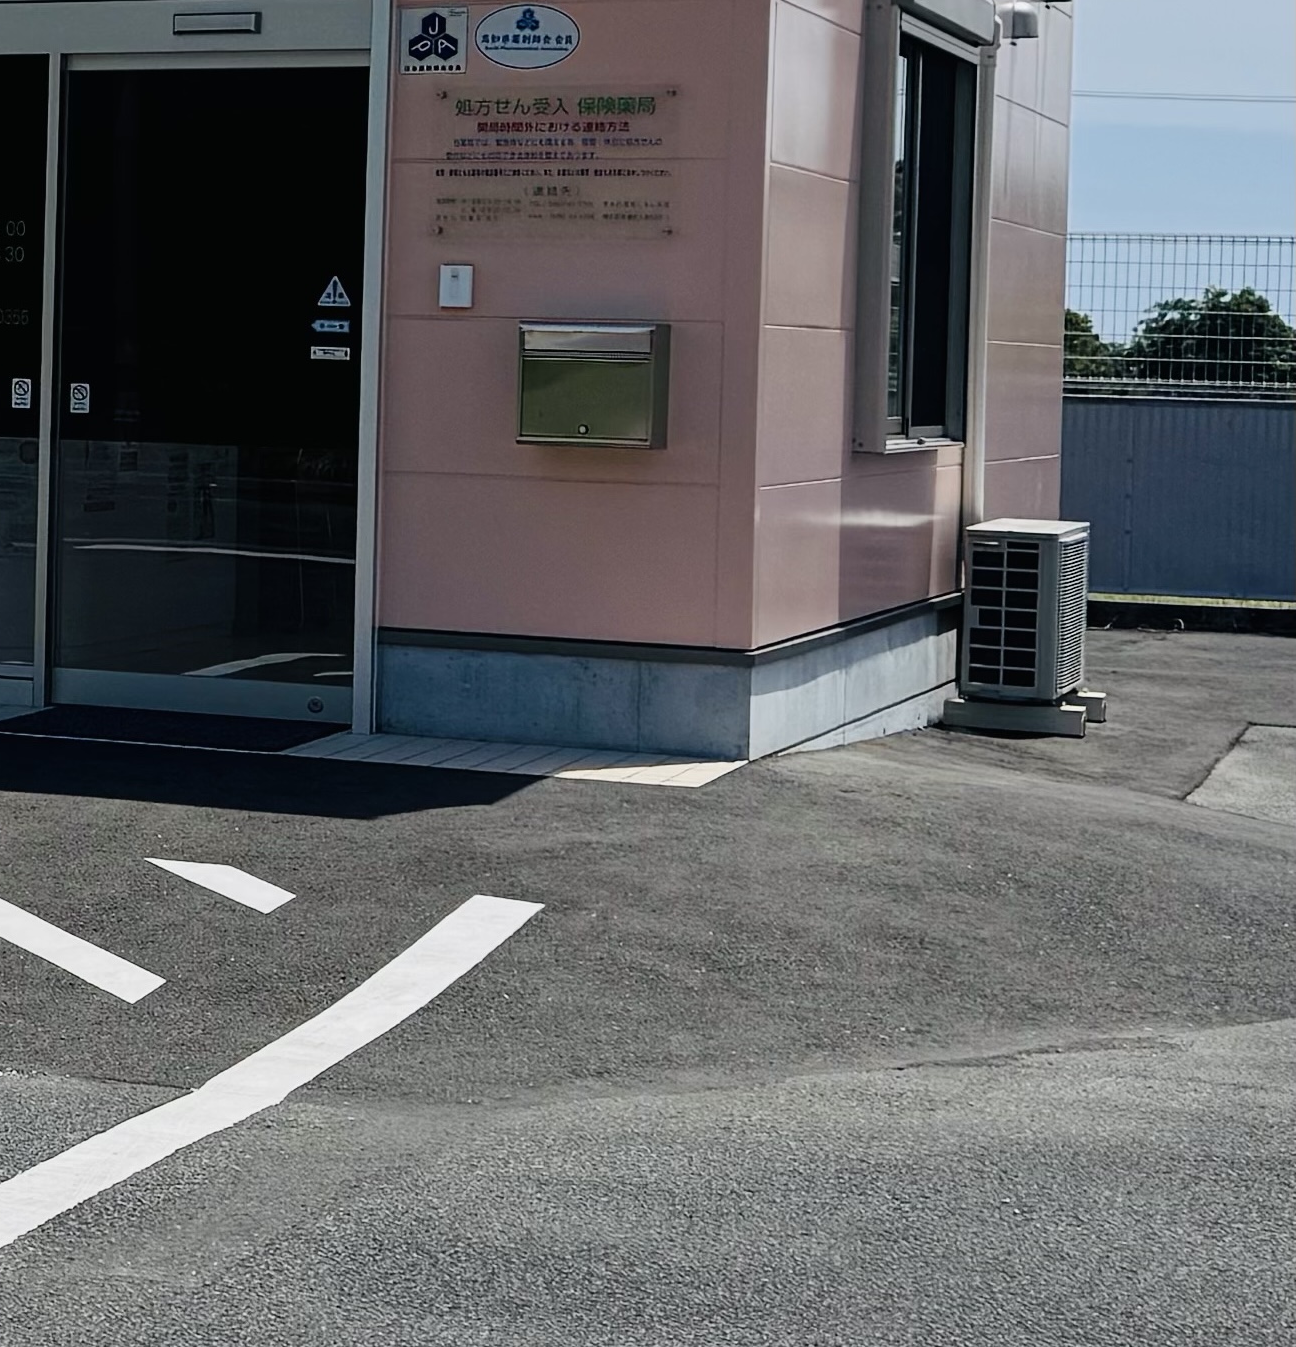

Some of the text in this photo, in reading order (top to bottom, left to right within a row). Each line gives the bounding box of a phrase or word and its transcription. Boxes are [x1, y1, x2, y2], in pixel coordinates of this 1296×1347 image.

[455, 96, 657, 117] 処方せん受入 保険薬局
